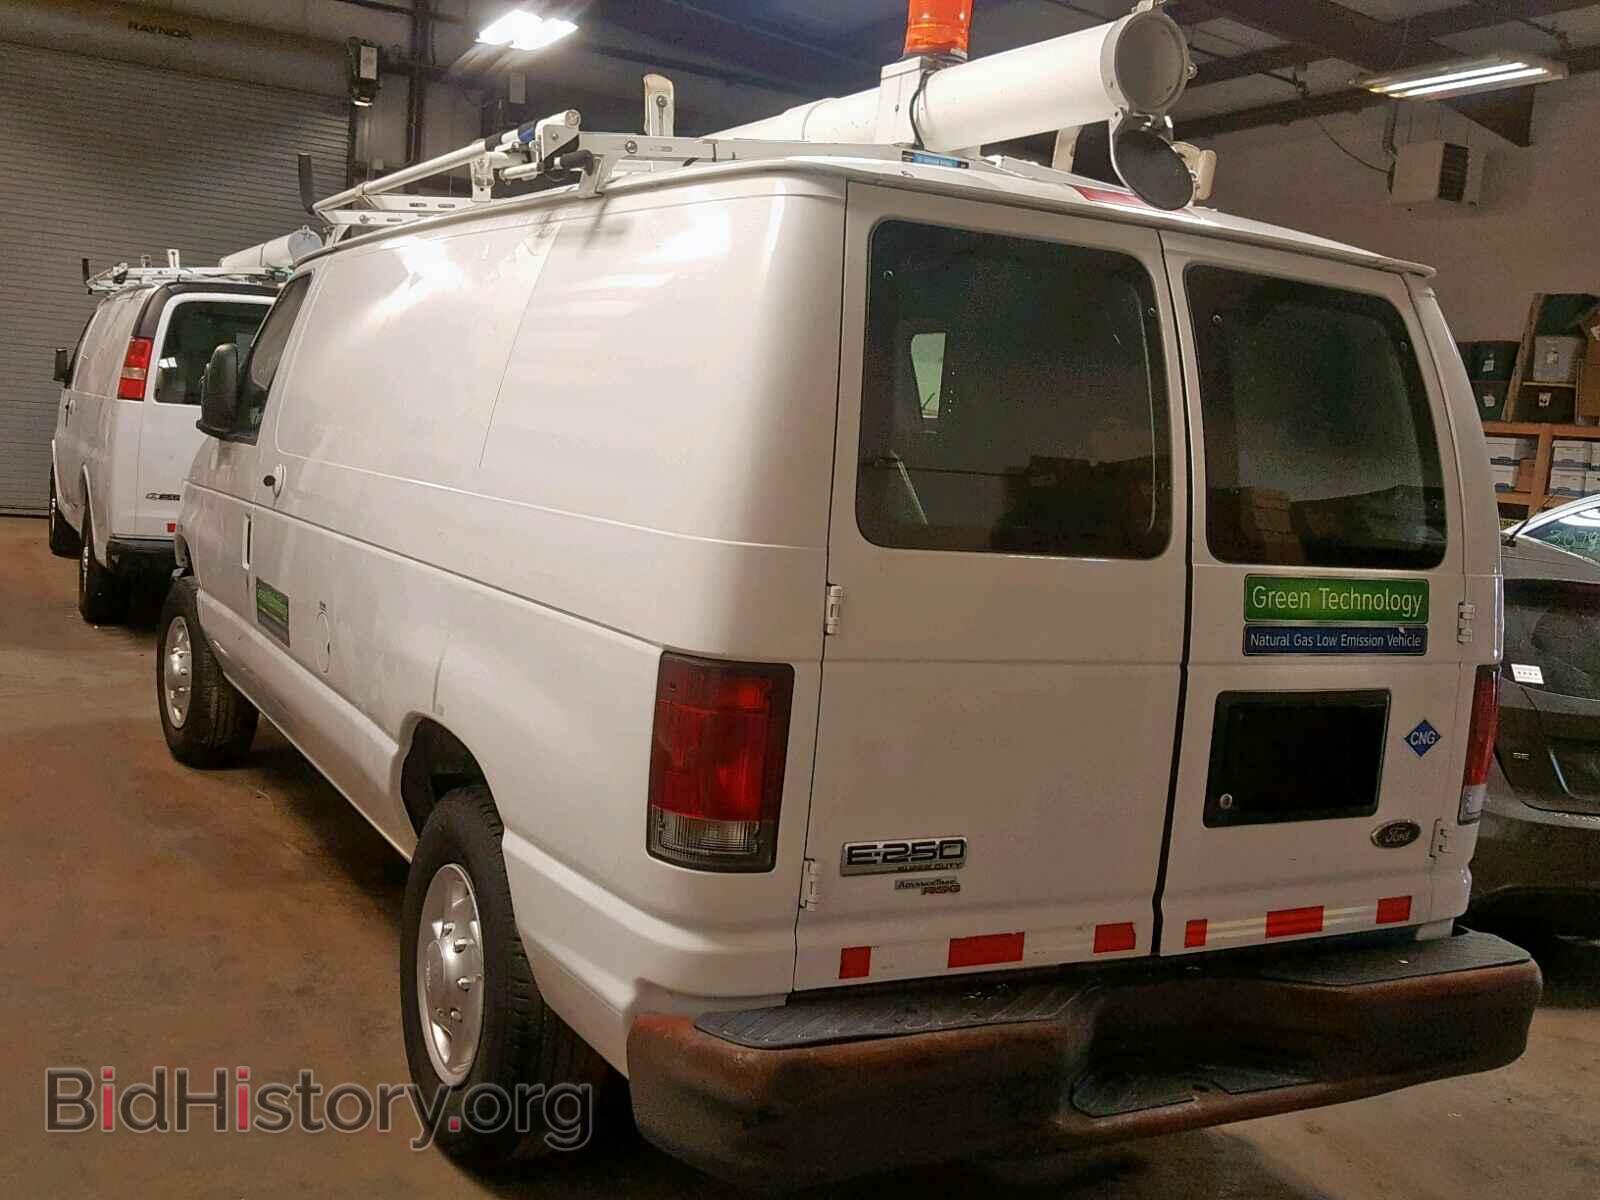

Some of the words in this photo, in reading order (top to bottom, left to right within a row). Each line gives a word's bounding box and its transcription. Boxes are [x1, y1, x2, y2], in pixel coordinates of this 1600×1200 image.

[1252, 585, 1311, 609] Green
[1318, 587, 1422, 617] Technology
[1250, 633, 1290, 647] Natural
[1293, 634, 1313, 647] Gas
[1317, 634, 1338, 647] Low
[1341, 634, 1384, 647] Emission
[1387, 634, 1421, 647] Vehicle
[1410, 731, 1436, 746] CNG
